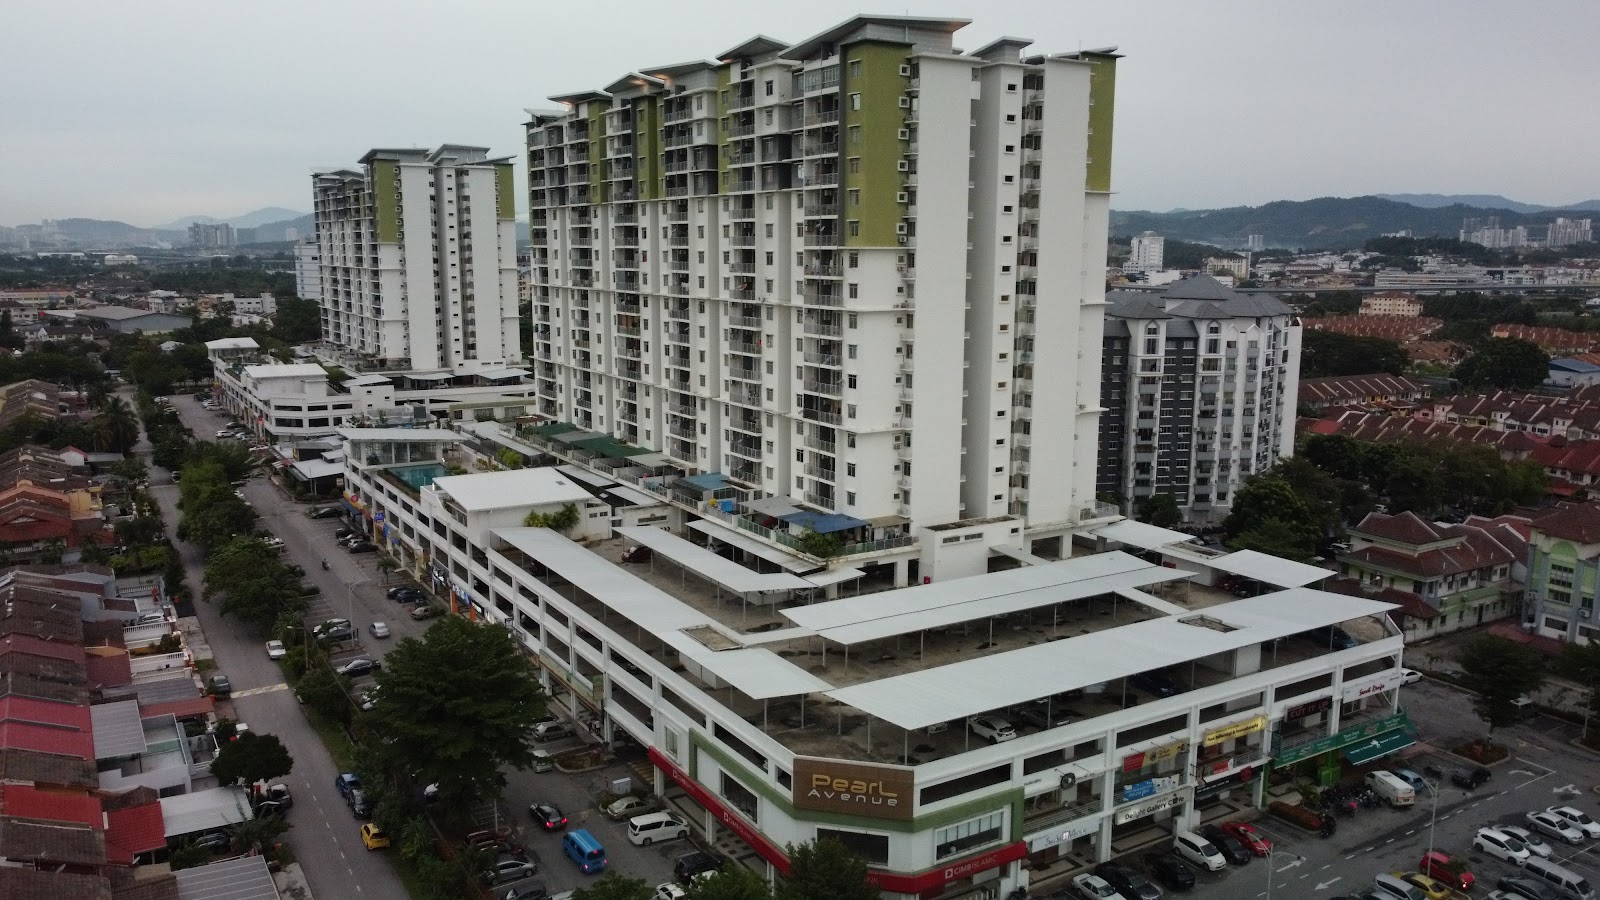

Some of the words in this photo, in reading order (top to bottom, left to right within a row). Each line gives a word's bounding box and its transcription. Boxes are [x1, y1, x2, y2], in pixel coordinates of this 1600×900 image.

[1125, 808, 1147, 820] Delight
[1147, 802, 1167, 814] Gallery
[954, 863, 972, 875] CIMB
